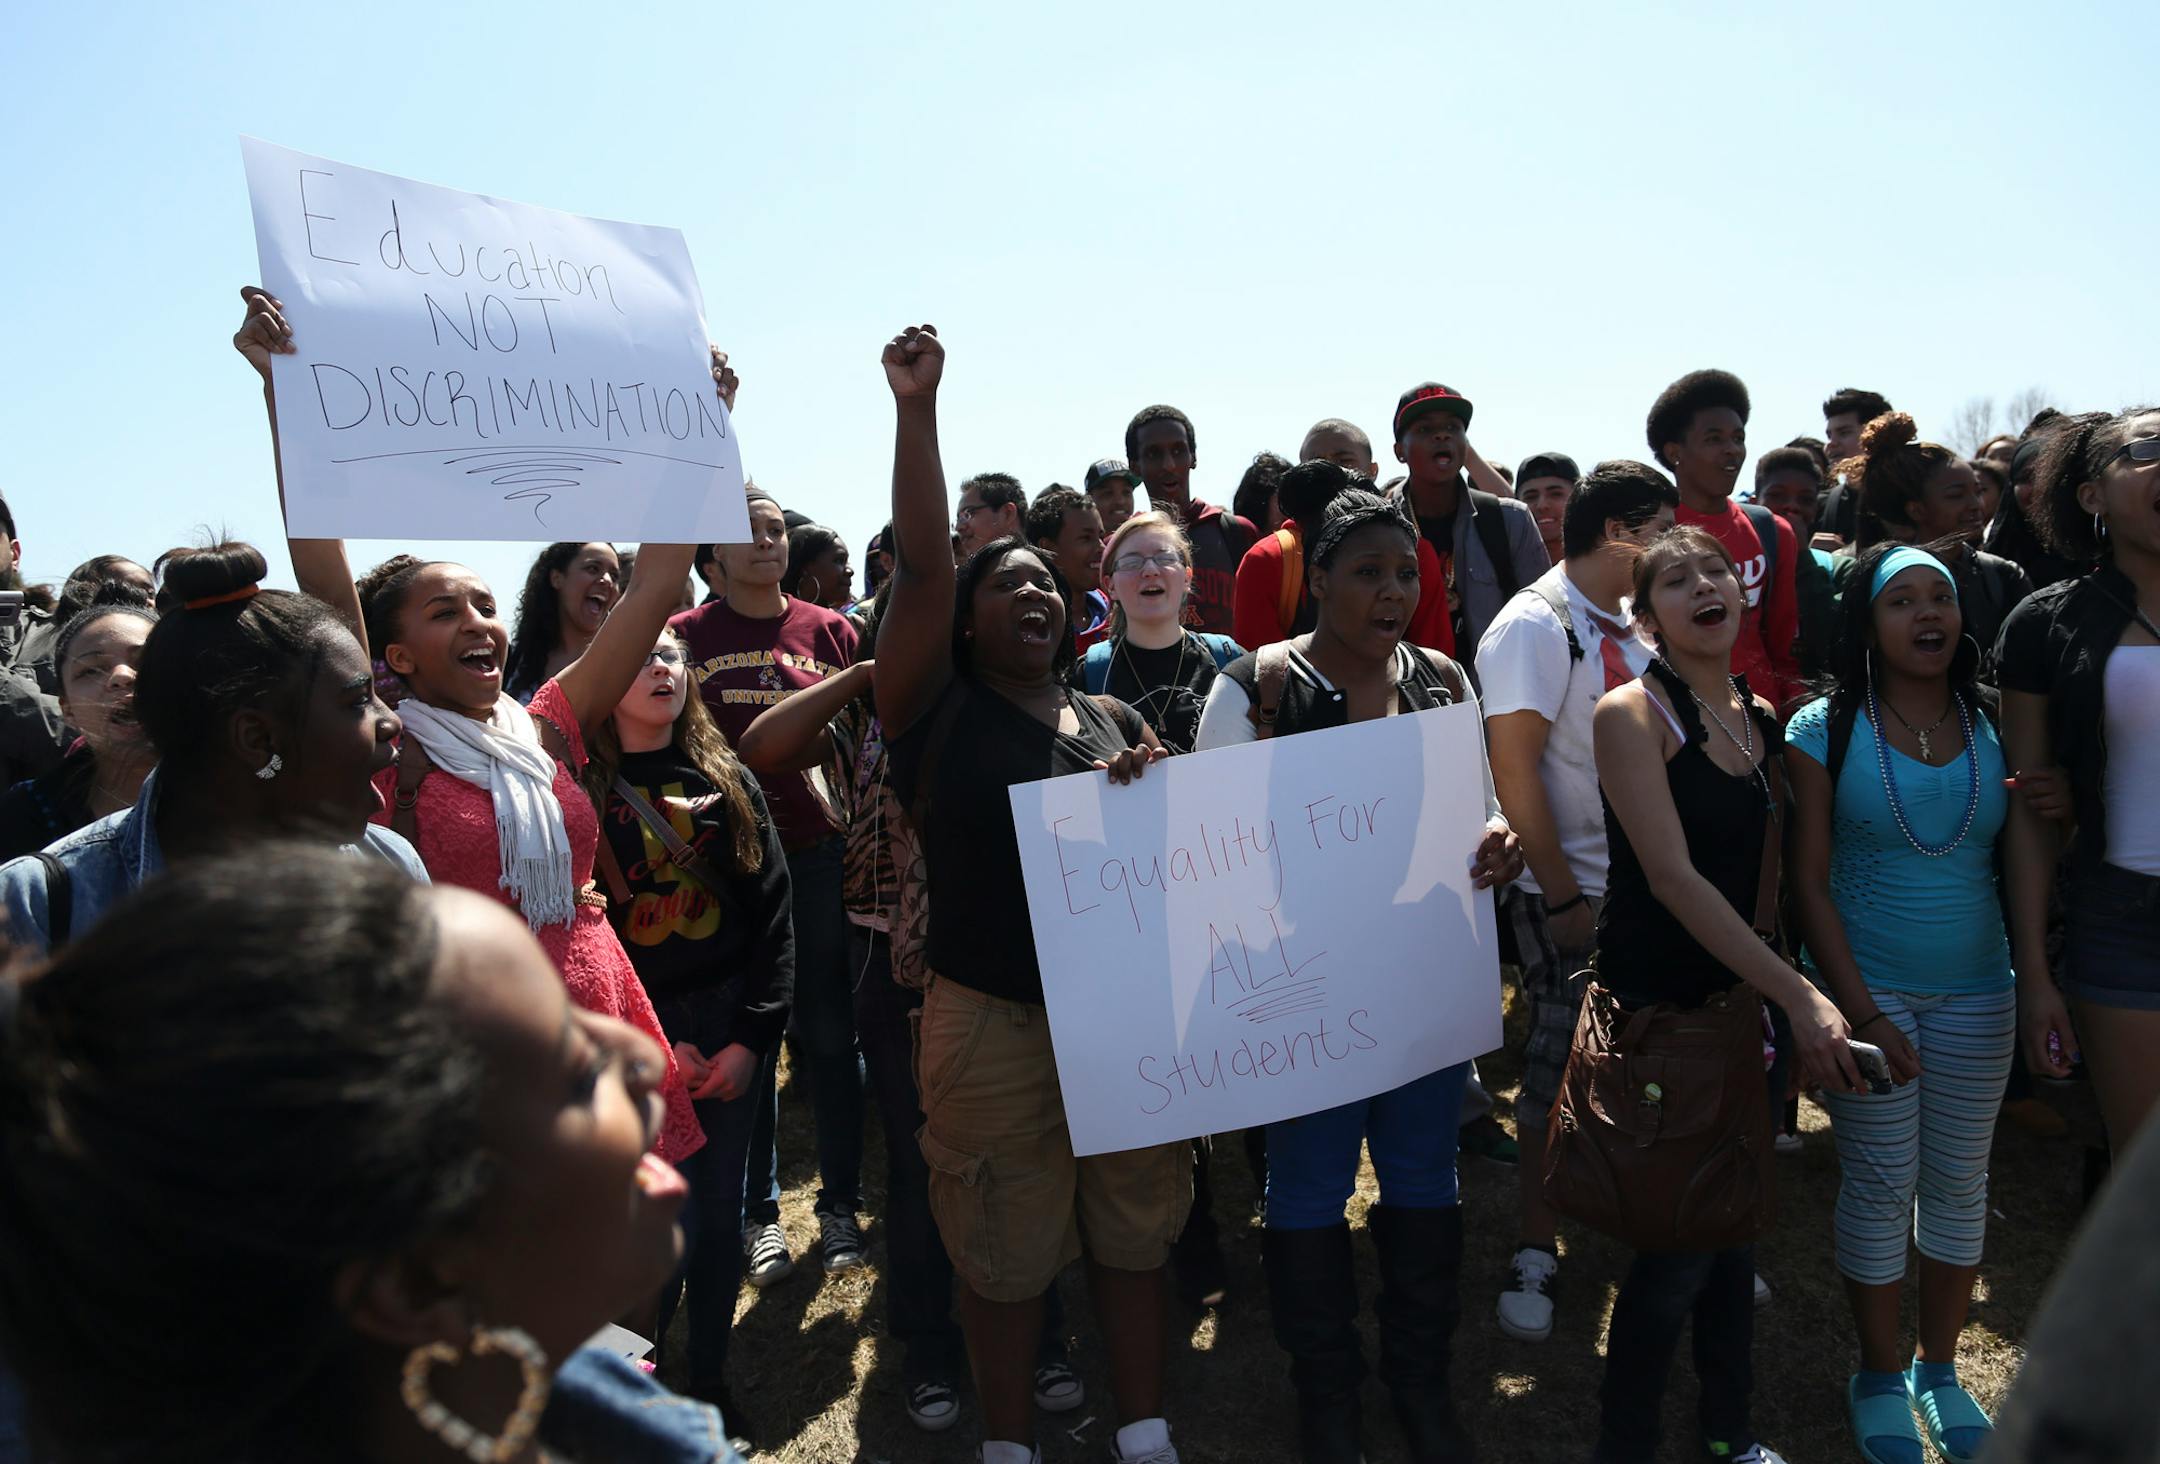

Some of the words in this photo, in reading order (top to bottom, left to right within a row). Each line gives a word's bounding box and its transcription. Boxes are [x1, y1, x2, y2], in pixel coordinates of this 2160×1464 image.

[299, 168, 624, 315] Education
[423, 292, 561, 355] NOT
[309, 363, 727, 442] DISCRIMINATION
[694, 649, 777, 685] ARIZONA
[720, 688, 801, 706] UNIVER
[1053, 815, 1284, 934] Equality
[1304, 794, 1388, 850] For
[1208, 912, 1328, 1005] ALL
[1137, 1008, 1379, 1115] Students
